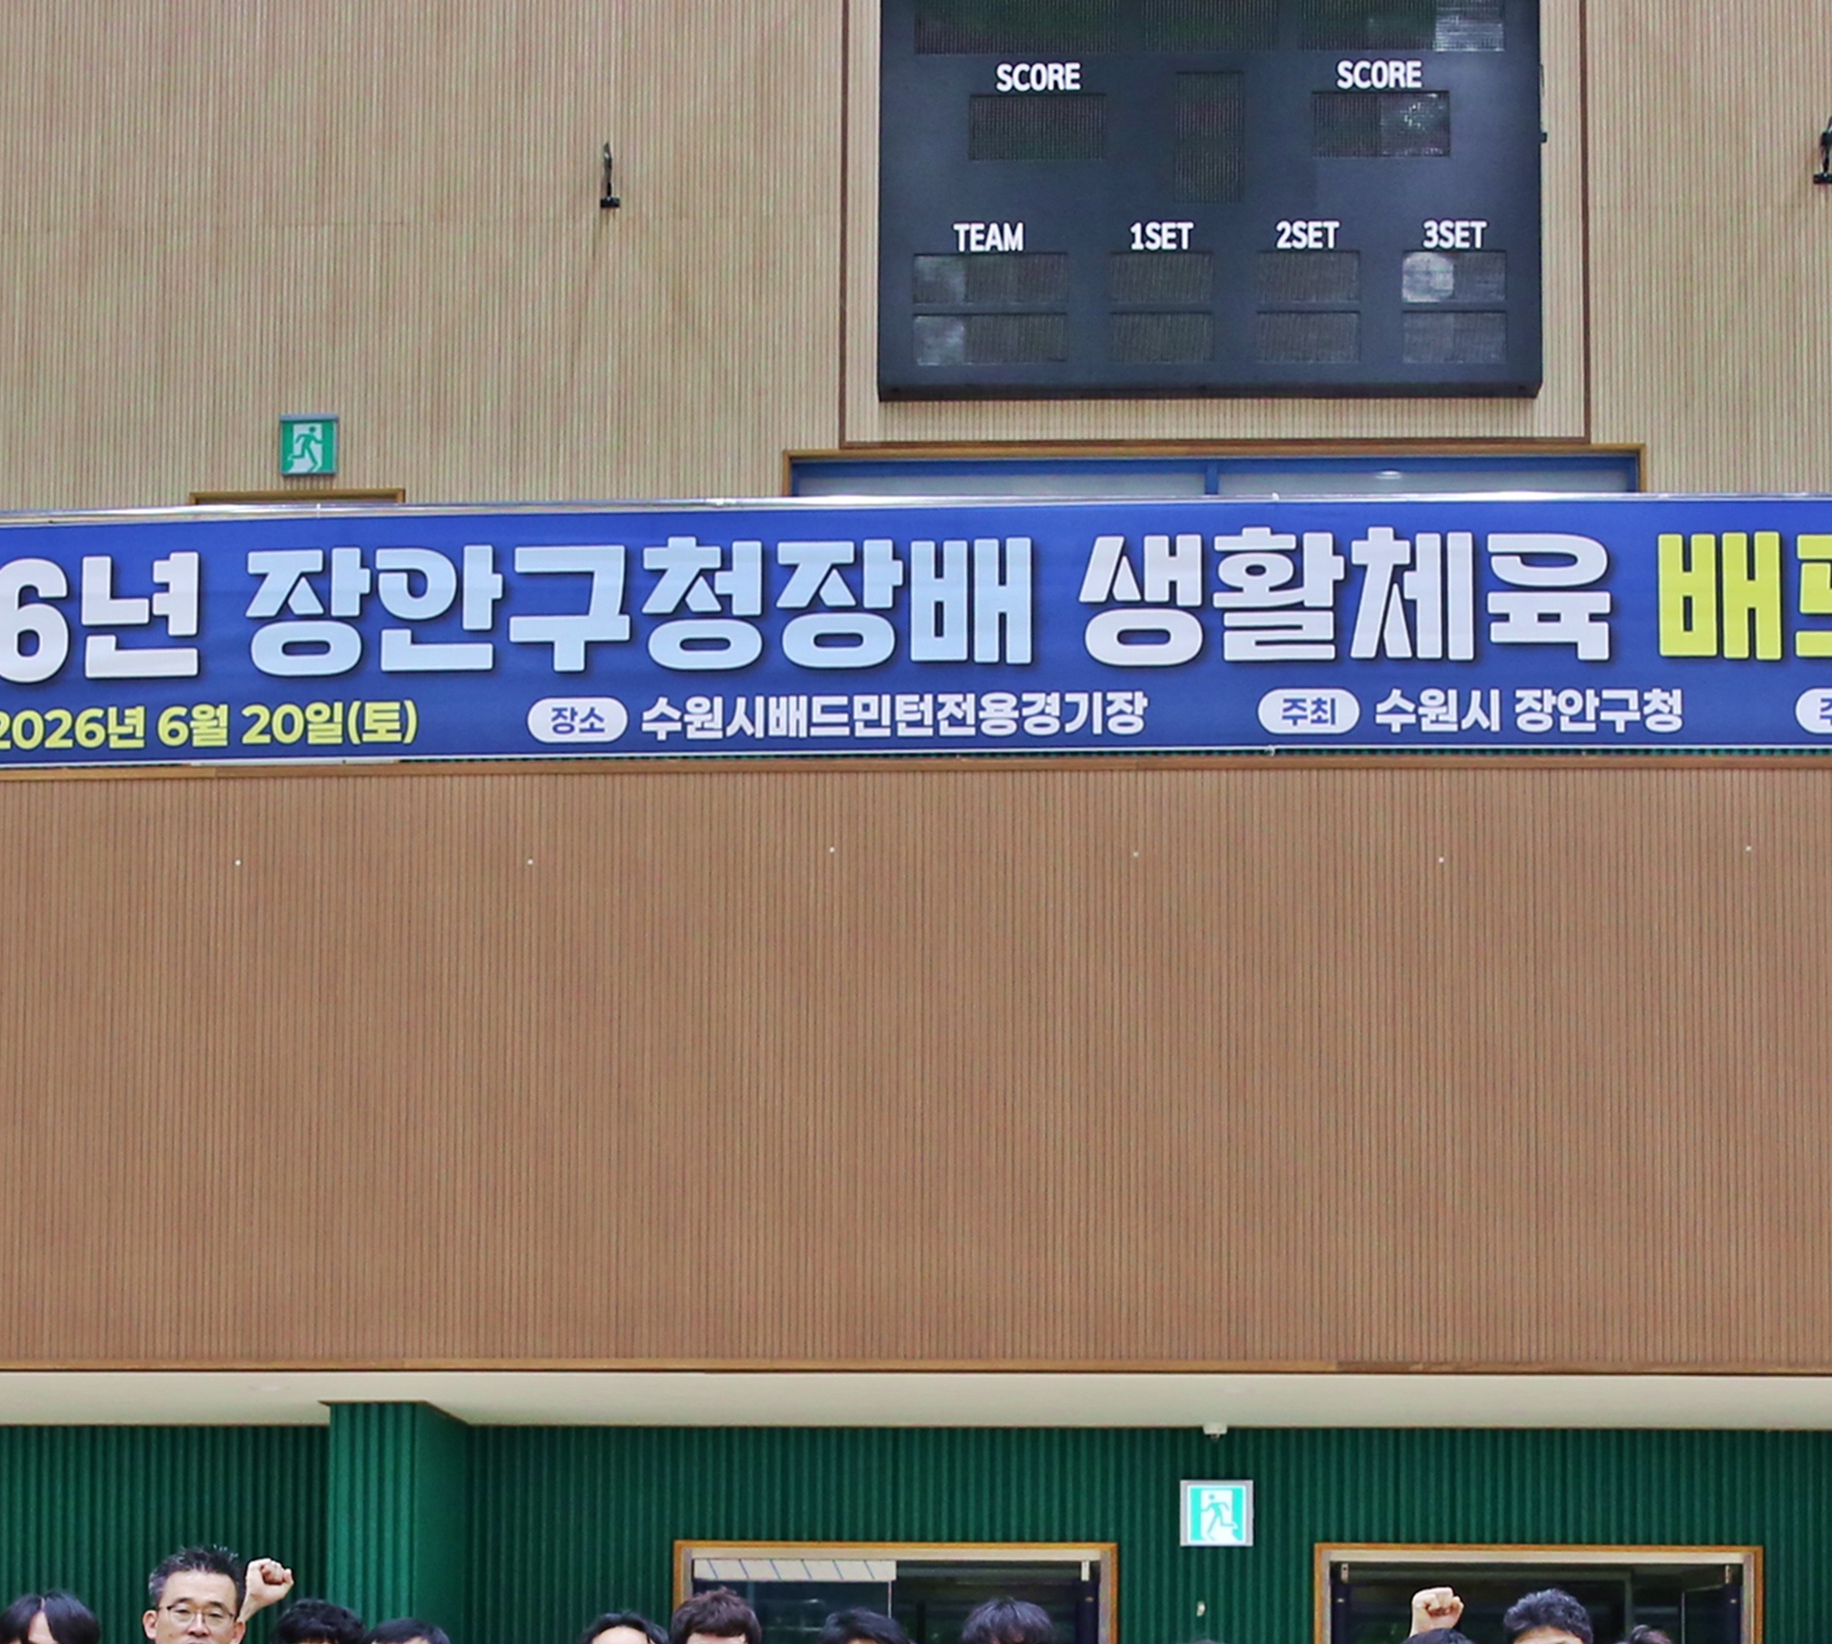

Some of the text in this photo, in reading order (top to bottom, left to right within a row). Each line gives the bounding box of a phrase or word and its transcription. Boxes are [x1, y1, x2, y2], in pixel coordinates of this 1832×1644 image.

[997, 63, 1080, 91] SCORE
[1338, 61, 1422, 88] SCORE
[954, 223, 1023, 251] TEAM
[1131, 222, 1193, 250] 1SET
[1277, 221, 1339, 248] 2SET
[1424, 220, 1487, 248] 3SET
[247, 537, 1030, 675] 장안구청장배
[1080, 527, 1610, 665] 생활체육
[159, 705, 227, 746] 6월
[242, 701, 416, 743] 20일(토)
[552, 707, 605, 734] 장소
[642, 692, 1147, 739] 수원시배드민턴전용경기장
[1282, 698, 1335, 726] 주최
[1376, 689, 1682, 732] 수원시 장안구청
